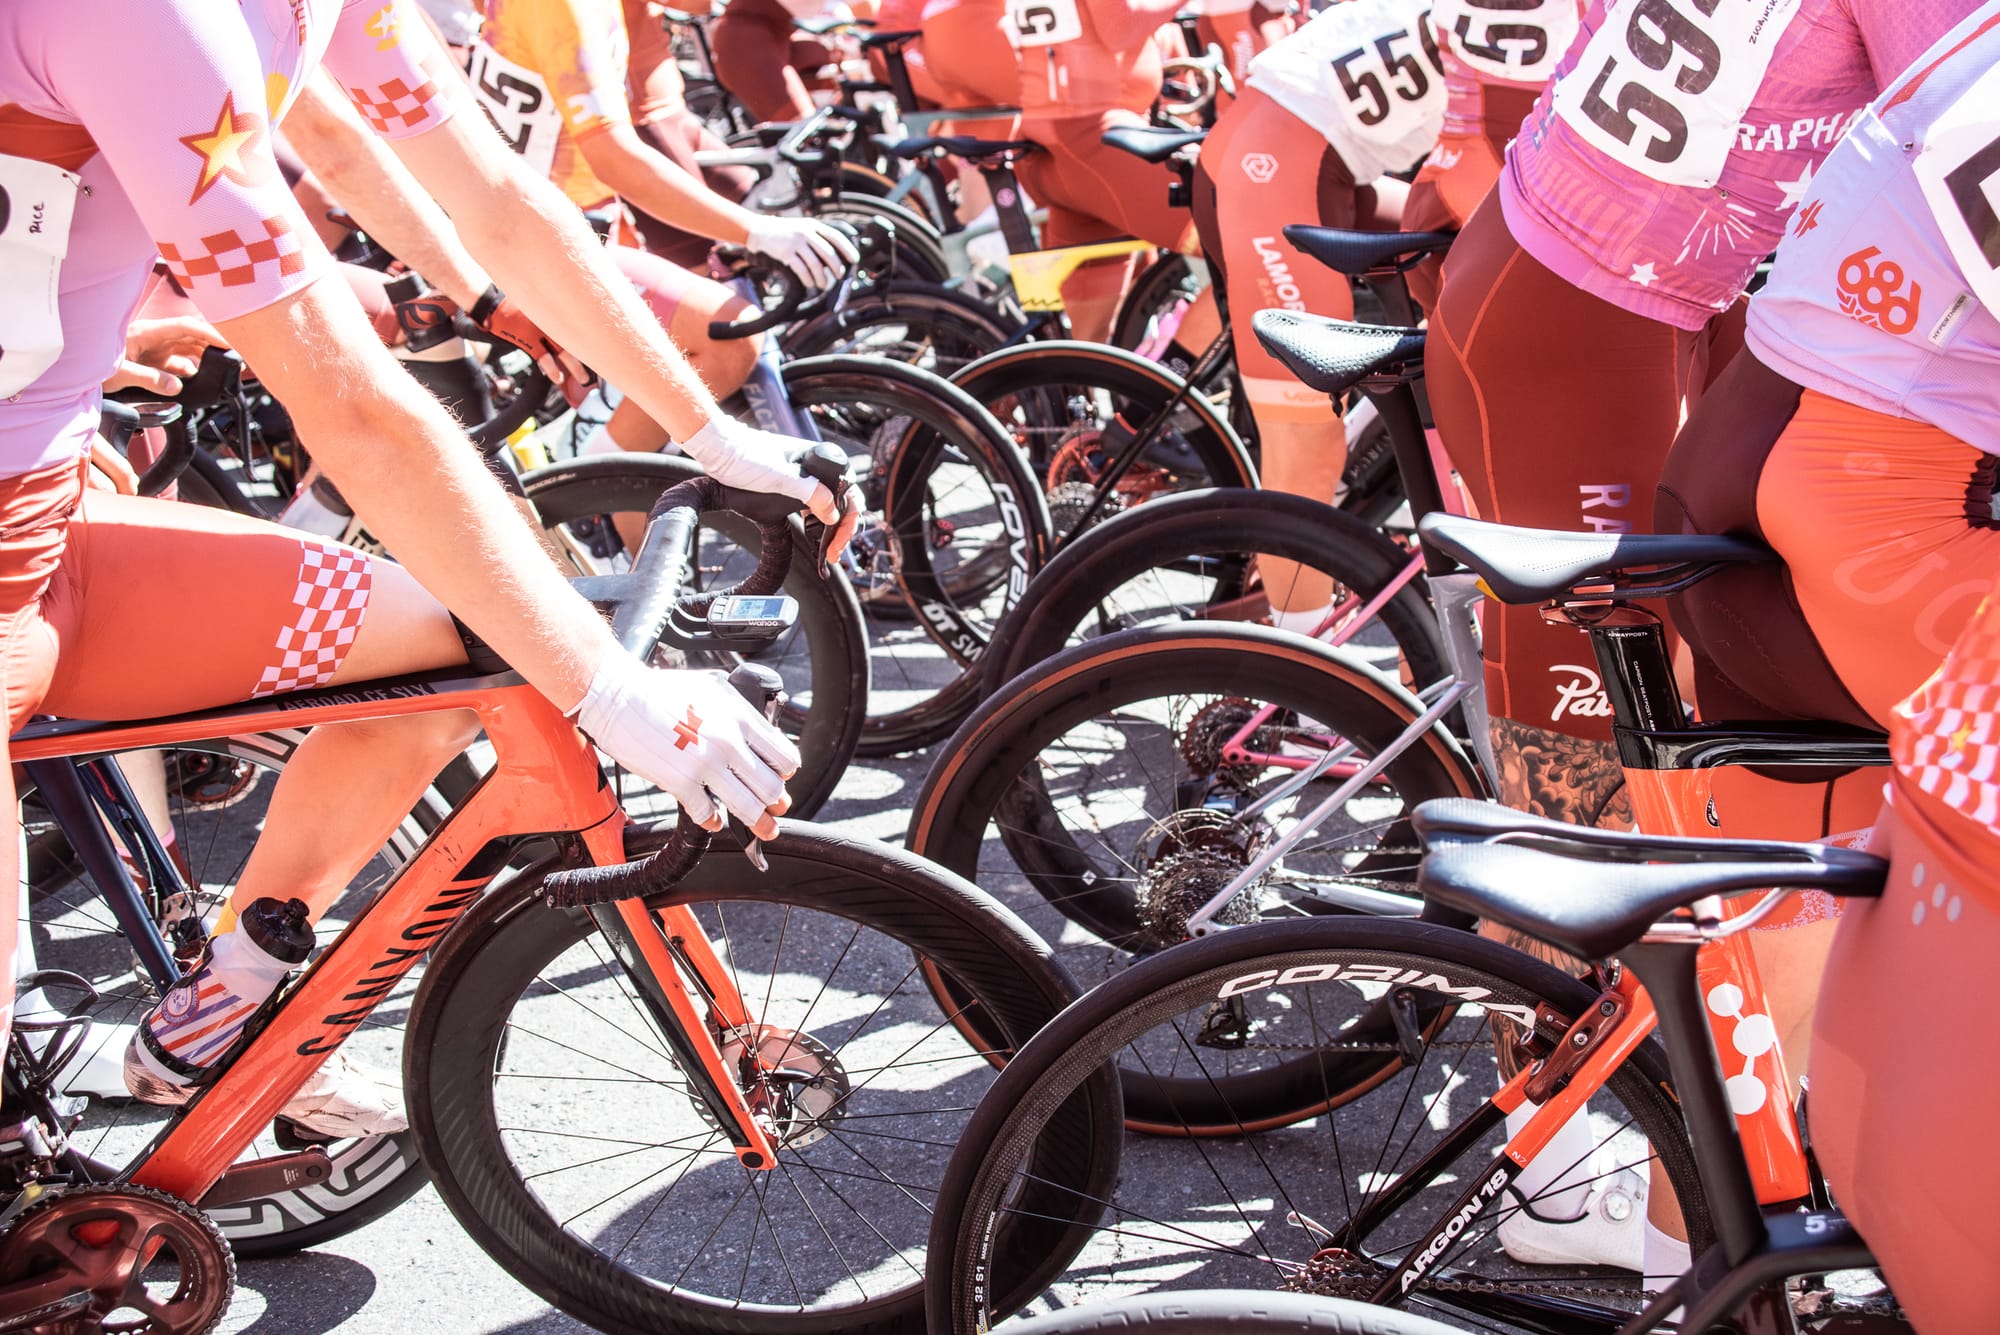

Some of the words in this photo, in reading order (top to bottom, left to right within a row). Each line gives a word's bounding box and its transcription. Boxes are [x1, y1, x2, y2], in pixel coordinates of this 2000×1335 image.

[1014, 6, 1056, 35] 5
[1453, 0, 1549, 66] 5
[1580, 0, 1722, 163] 59
[1217, 963, 1537, 1030] CORIMA
[1401, 1194, 1484, 1293] ARGON
[1480, 1168, 1509, 1198] 18
[975, 1286, 984, 1302] 32
[976, 1265, 985, 1282] S1
